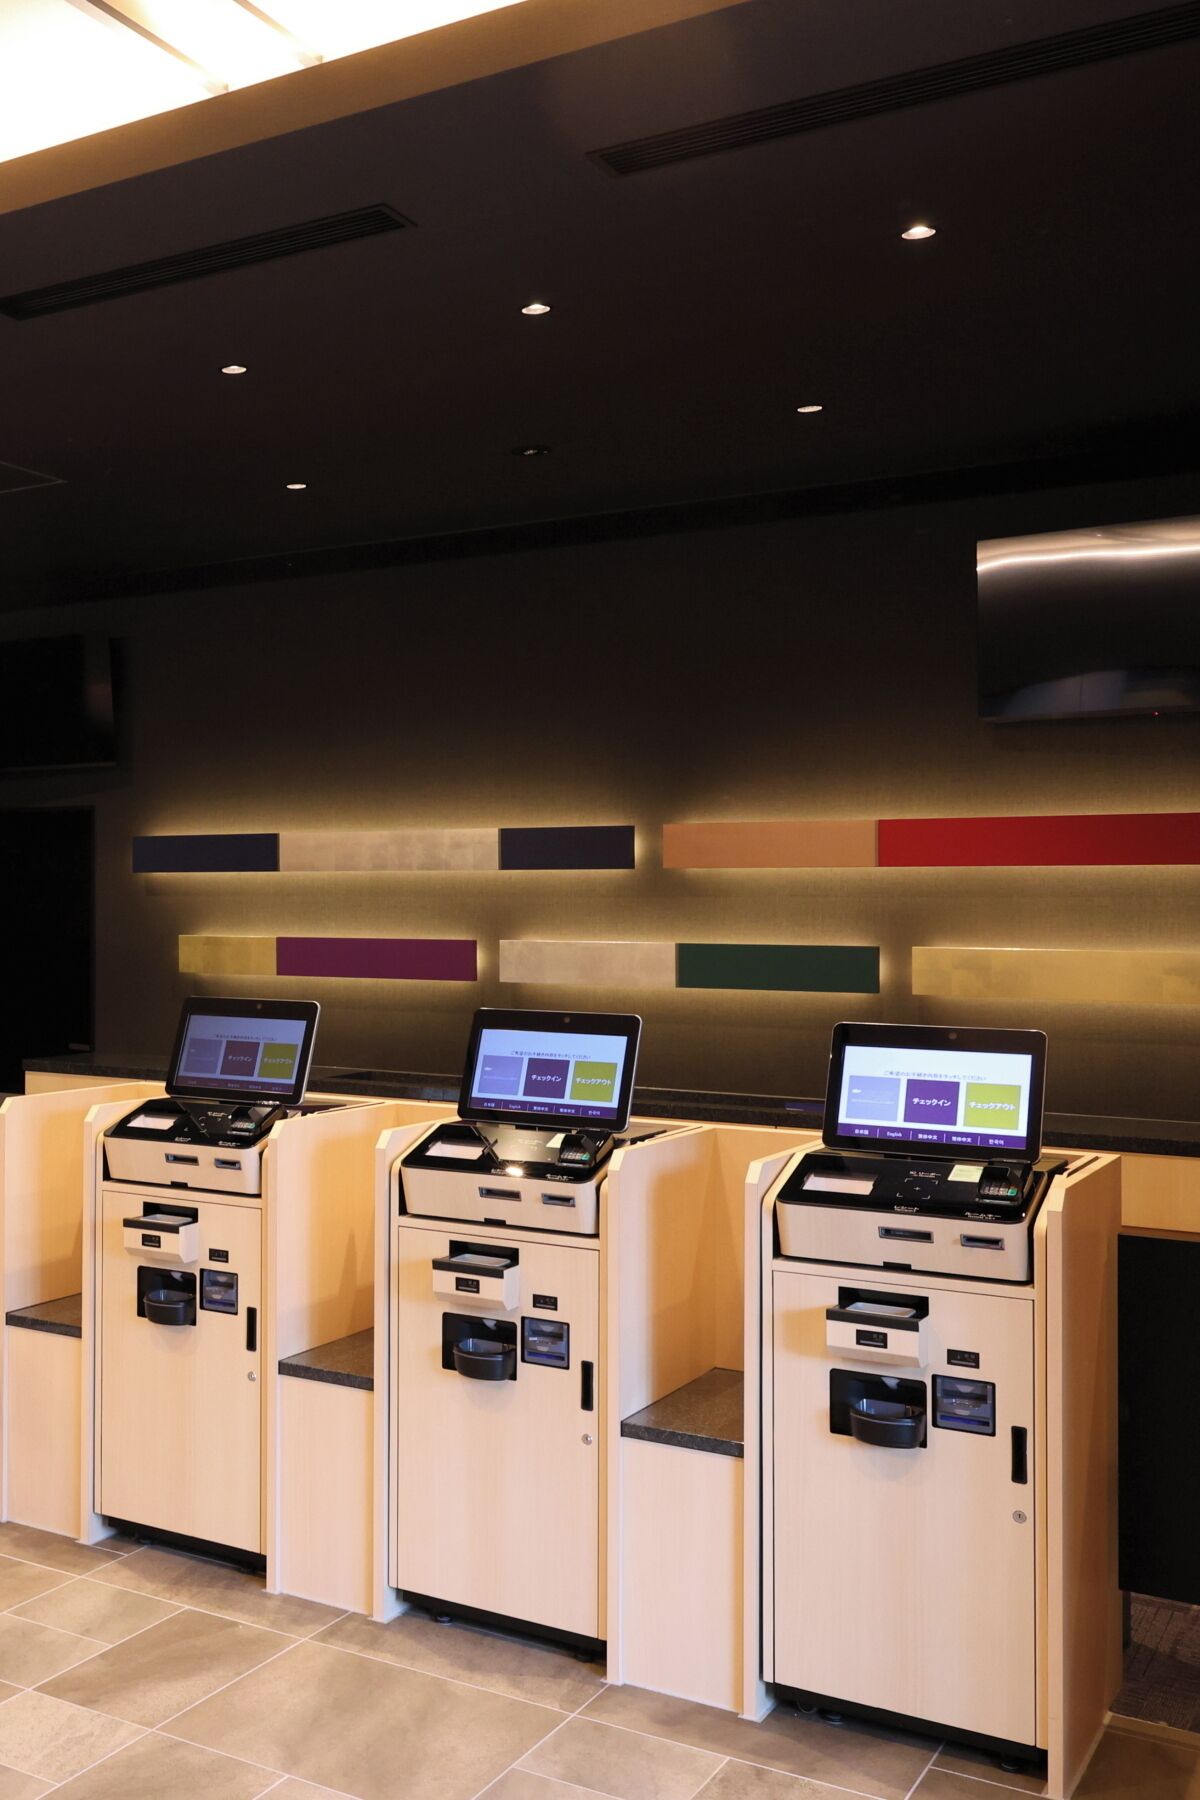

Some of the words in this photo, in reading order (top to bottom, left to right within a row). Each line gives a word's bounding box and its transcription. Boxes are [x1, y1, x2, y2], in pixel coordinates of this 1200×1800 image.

[530, 1074, 562, 1083] チェックイン
[575, 1077, 612, 1086] チェックアウト
[912, 1097, 952, 1107] チェックイン
[969, 1101, 1016, 1111] チェックアウト
